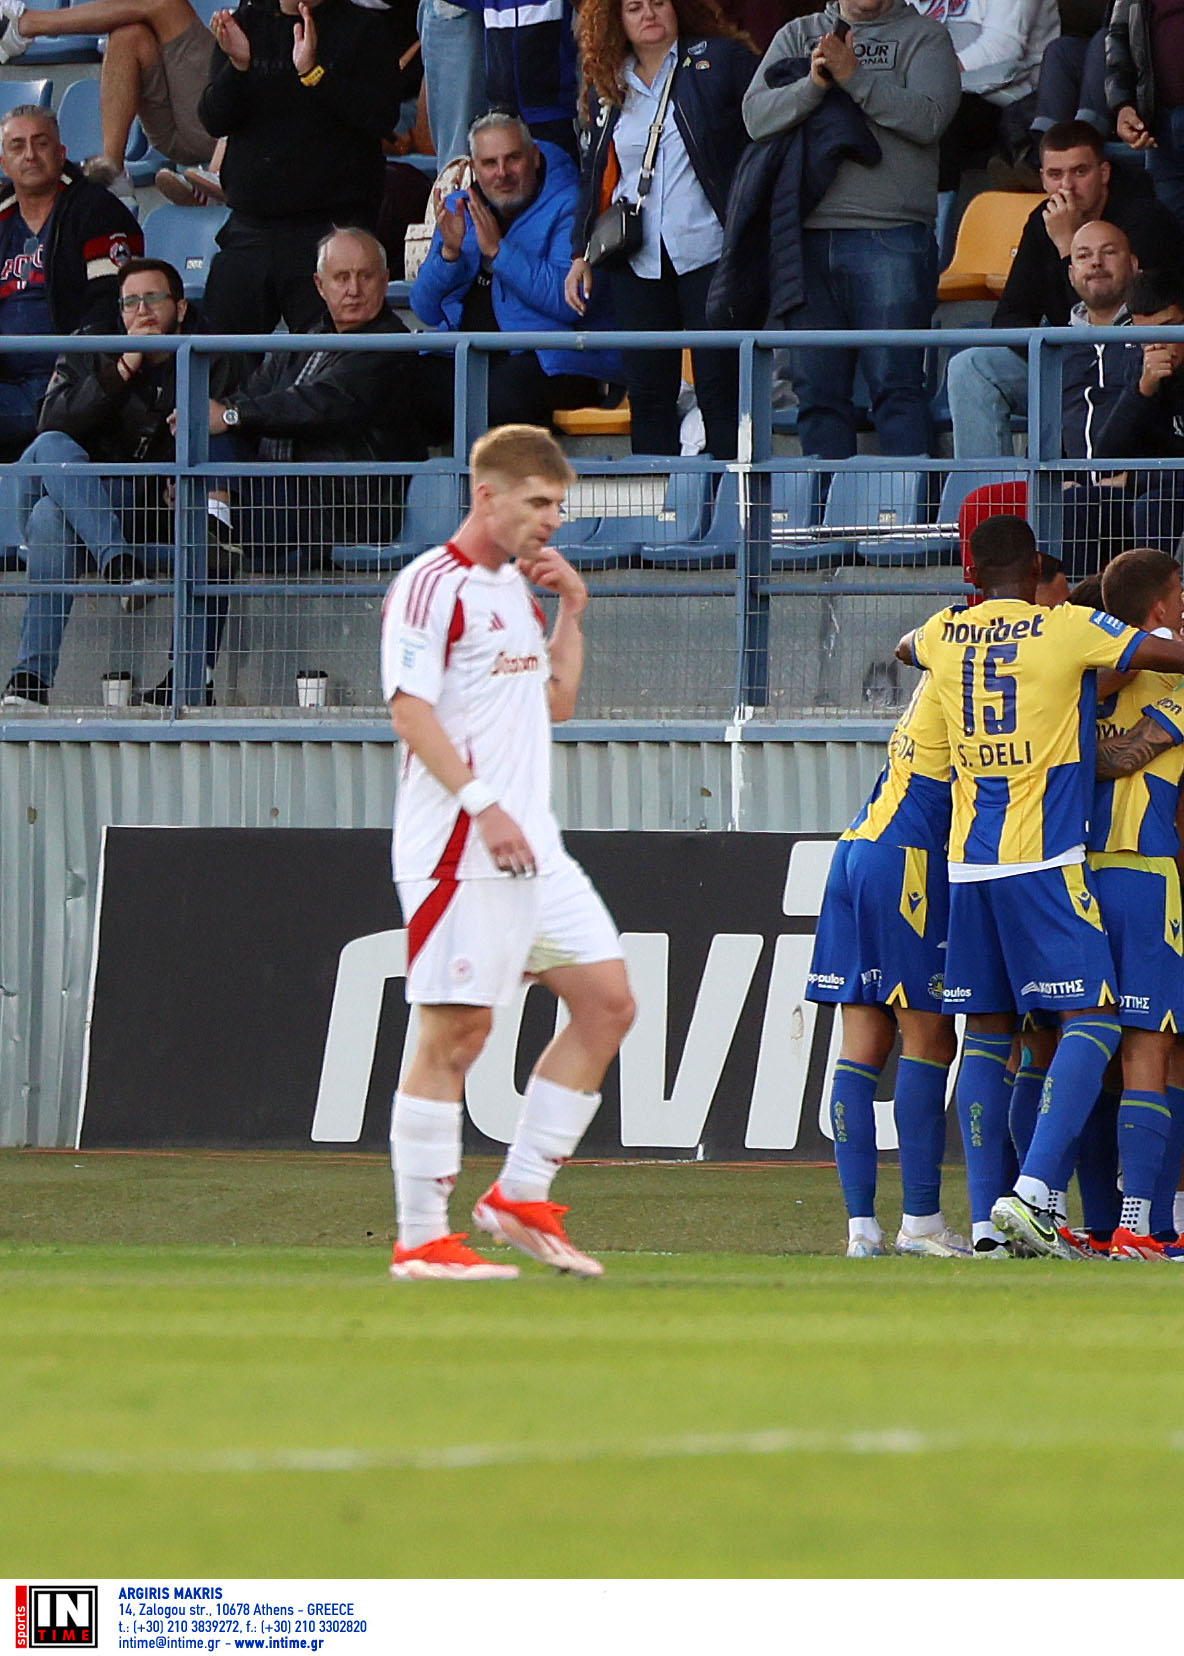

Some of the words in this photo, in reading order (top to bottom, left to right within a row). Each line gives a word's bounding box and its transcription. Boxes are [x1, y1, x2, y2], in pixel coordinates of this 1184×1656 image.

[941, 614, 1044, 644] novibet
[961, 642, 1019, 738] 15
[957, 743, 974, 767] S.
[979, 741, 1033, 767] DELI
